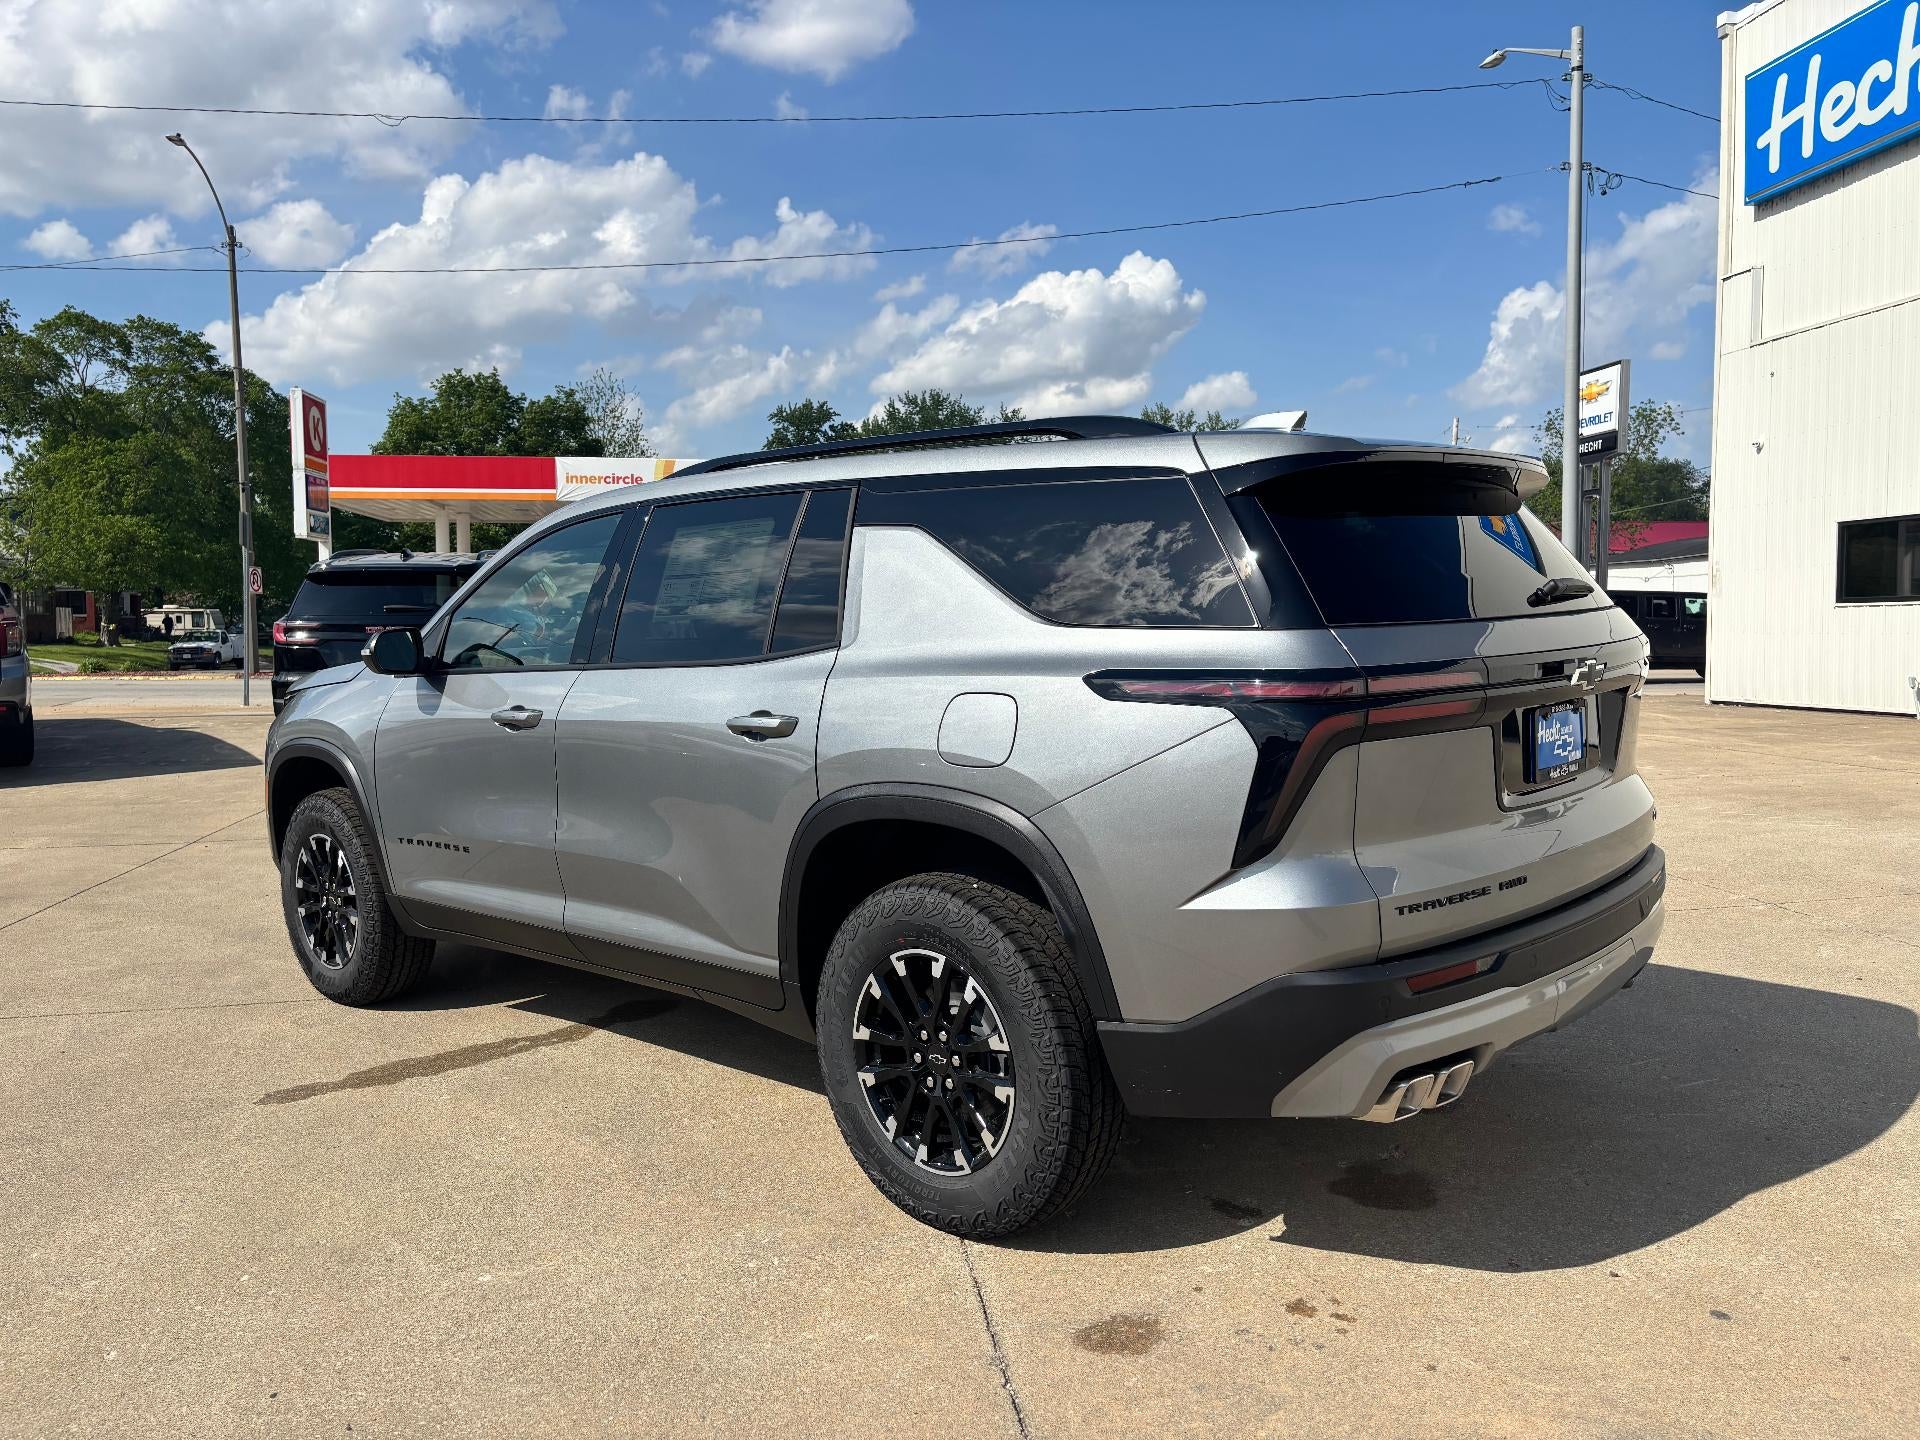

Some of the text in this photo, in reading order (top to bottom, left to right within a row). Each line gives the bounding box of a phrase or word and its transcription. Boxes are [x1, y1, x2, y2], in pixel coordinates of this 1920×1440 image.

[1580, 411, 1613, 429] EVROLET
[312, 415, 322, 446] K
[1579, 440, 1602, 454] HECHT
[565, 472, 643, 485] innercircle
[397, 837, 470, 853] TRAVERSE
[1394, 885, 1491, 915] TRAVERSE
